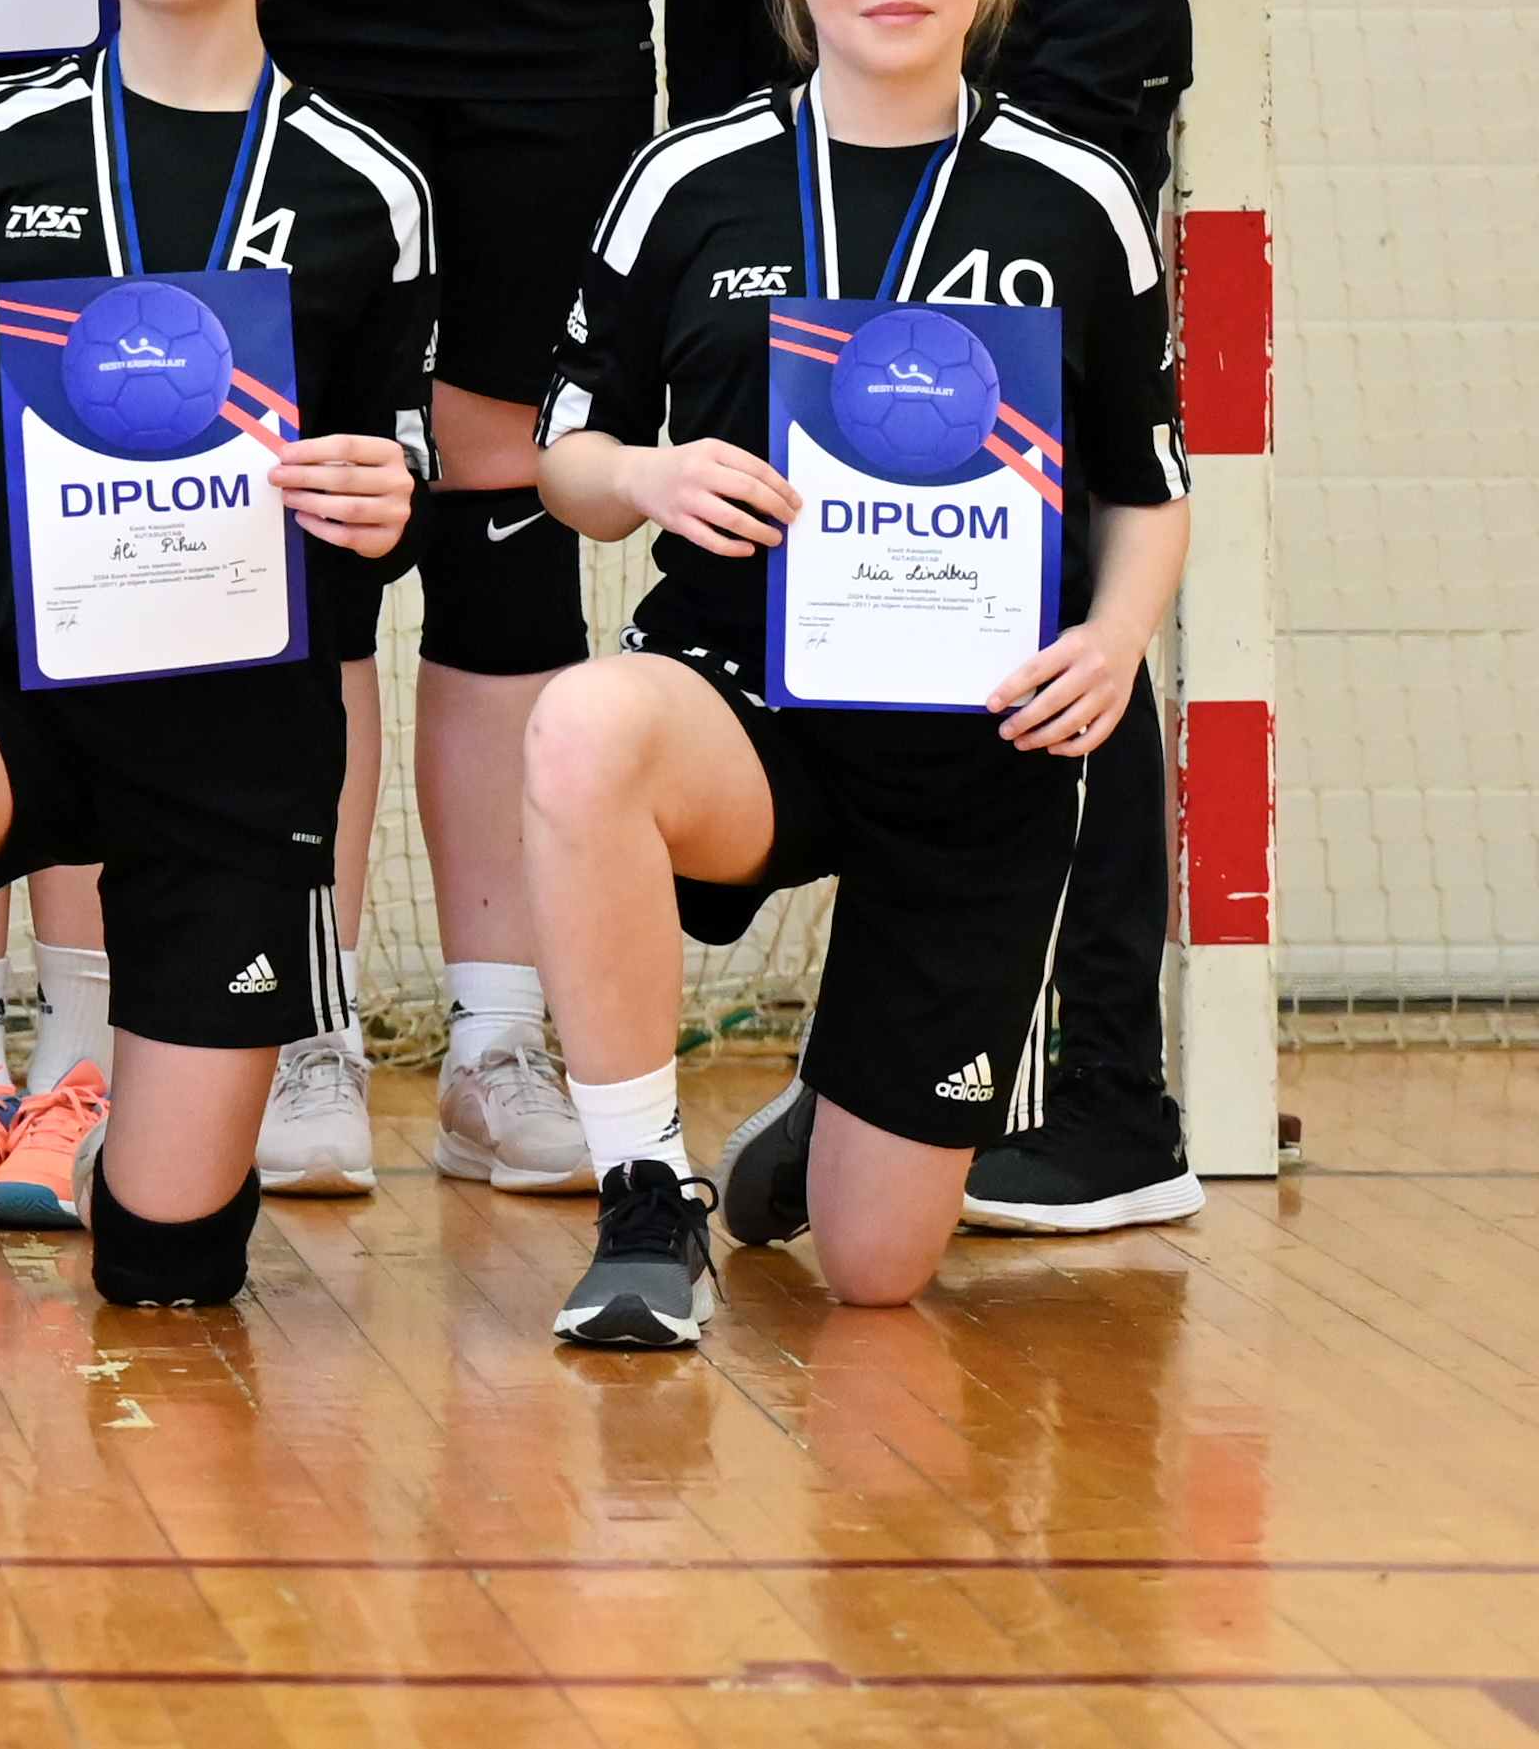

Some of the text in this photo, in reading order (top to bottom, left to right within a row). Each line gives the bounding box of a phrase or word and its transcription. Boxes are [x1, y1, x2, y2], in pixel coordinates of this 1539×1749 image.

[5, 205, 89, 231] TVSK
[709, 266, 793, 298] TVSK
[61, 474, 250, 517] DIPLOM
[822, 500, 1008, 539] DIPLOM
[851, 562, 893, 581] Mia
[935, 1082, 994, 1102] adidas
